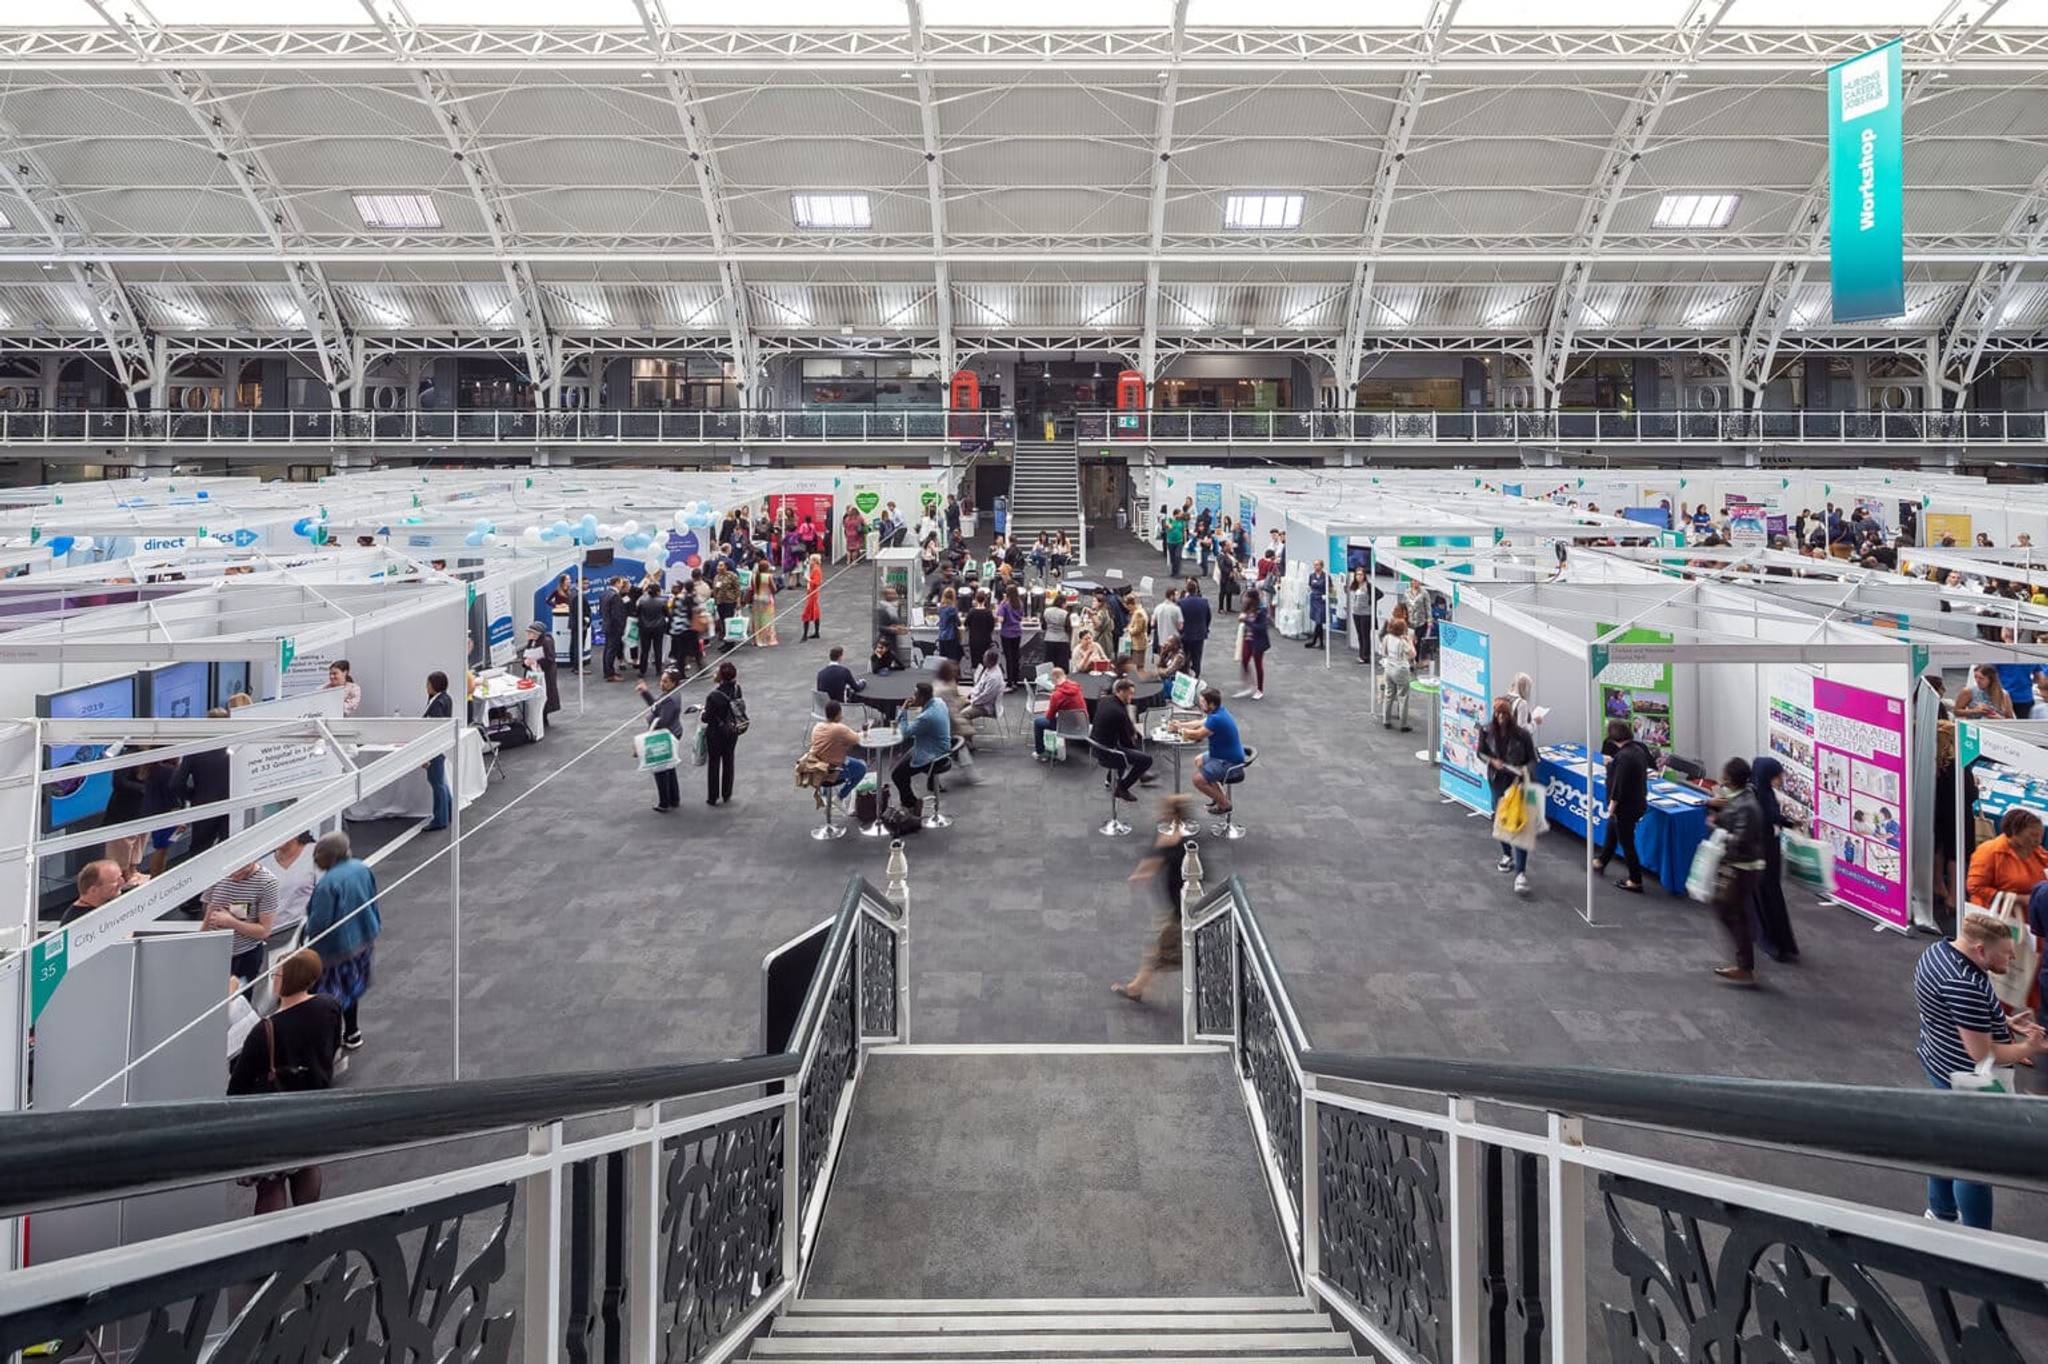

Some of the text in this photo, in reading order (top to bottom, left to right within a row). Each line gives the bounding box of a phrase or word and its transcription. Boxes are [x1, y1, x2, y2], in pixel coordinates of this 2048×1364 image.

[1844, 70, 1881, 90] NURSING
[1844, 81, 1882, 100] CAREERS
[1859, 128, 1877, 231] Workshop
[144, 537, 185, 551] direct
[81, 702, 104, 713] 2019
[1818, 711, 1867, 735] CHELSEA
[1870, 725, 1898, 743] AND
[1819, 720, 1899, 755] WESTMINSTER
[1820, 732, 1873, 757] HOSPITAL
[74, 930, 96, 948] City,
[99, 902, 145, 934] University
[159, 875, 193, 900] London
[40, 962, 56, 982] 35
